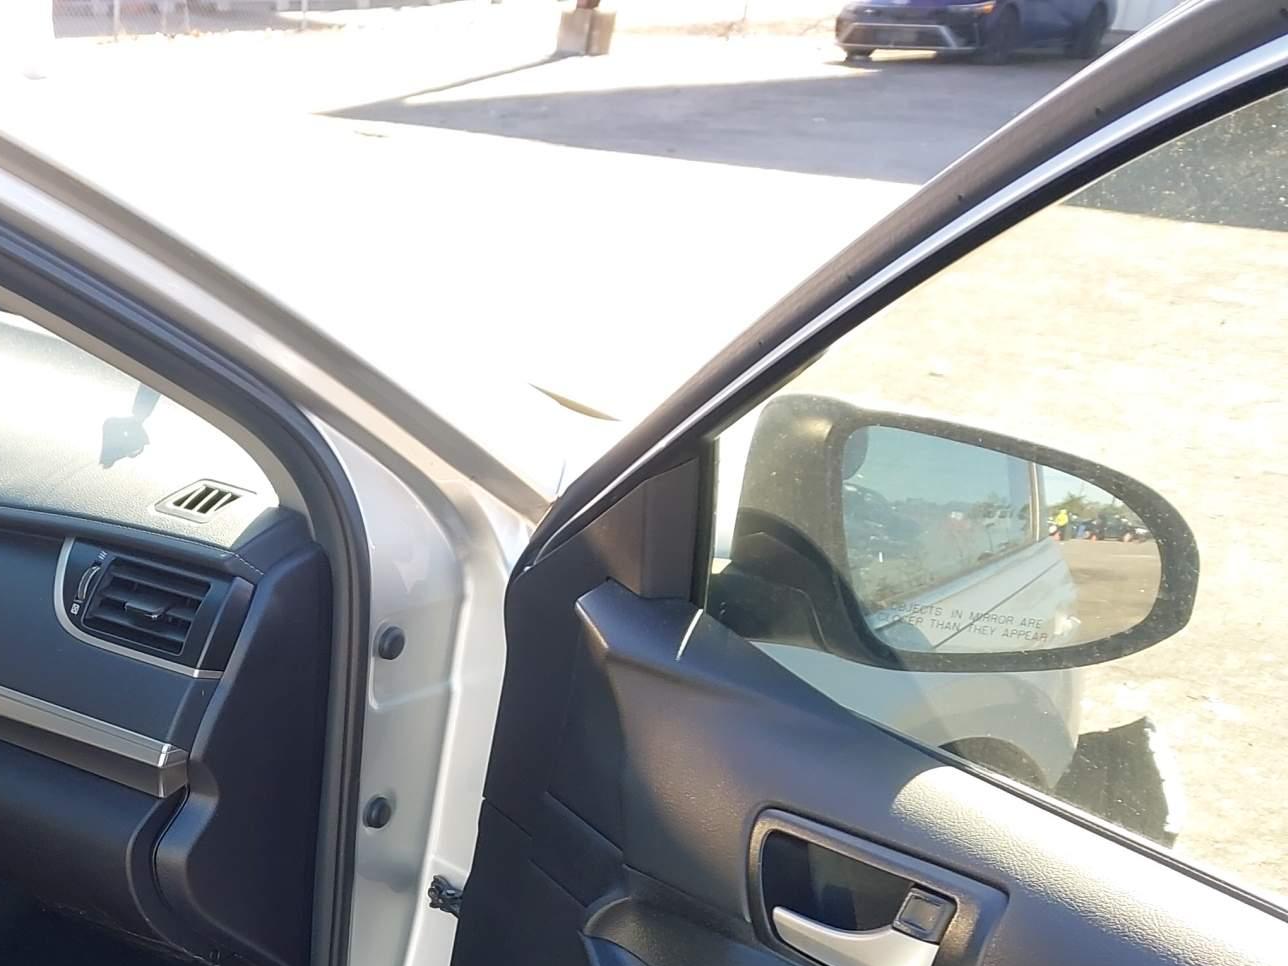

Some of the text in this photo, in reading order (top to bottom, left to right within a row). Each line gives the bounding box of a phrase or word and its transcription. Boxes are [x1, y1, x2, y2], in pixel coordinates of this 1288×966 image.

[930, 618, 961, 632] THAN
[967, 623, 996, 637] THEY
[1001, 628, 1049, 643] APPEAR
[951, 609, 963, 620] IN
[968, 609, 1015, 626] MIRROR
[1020, 617, 1044, 630] ARE
